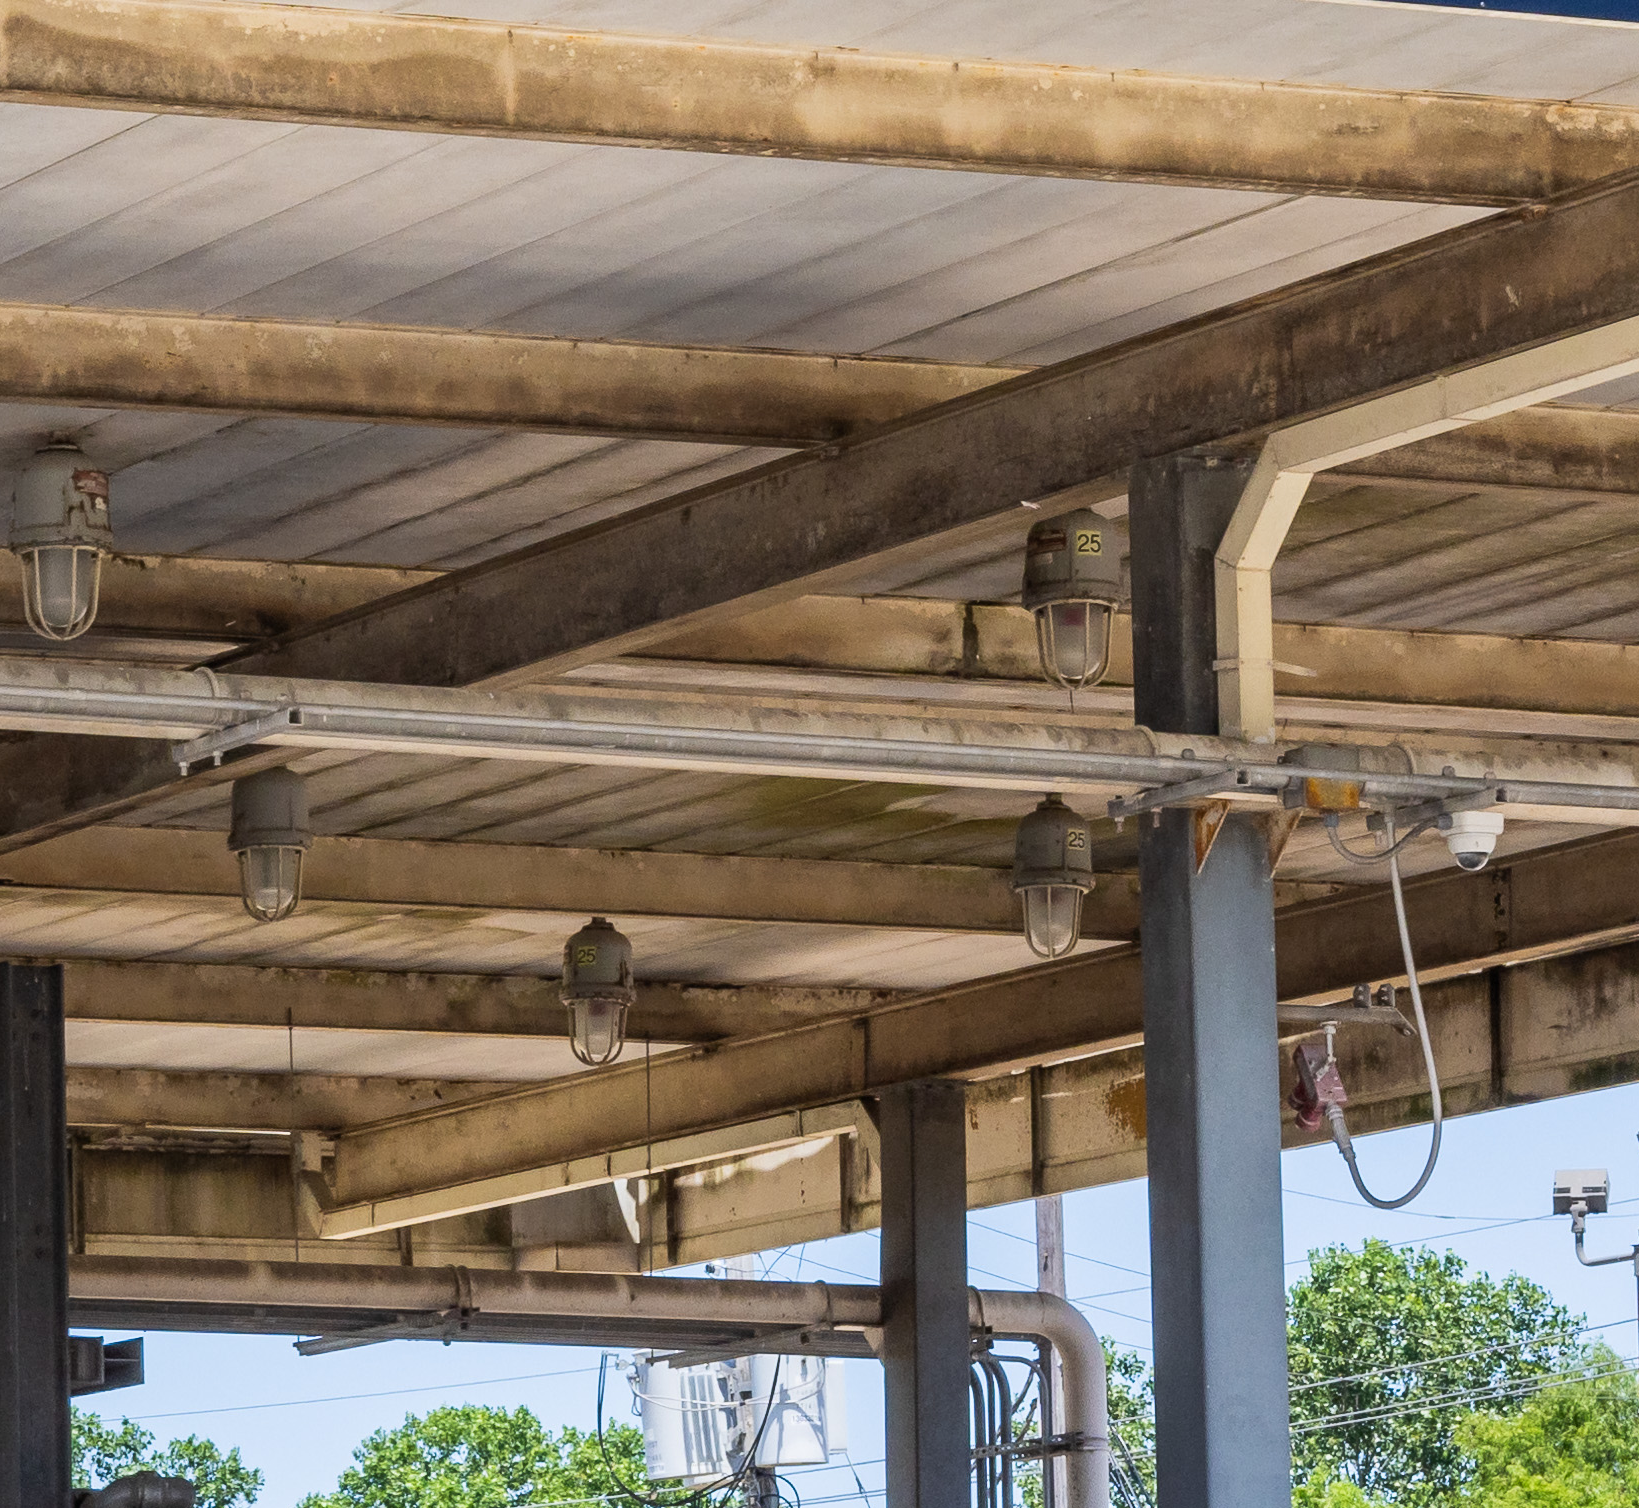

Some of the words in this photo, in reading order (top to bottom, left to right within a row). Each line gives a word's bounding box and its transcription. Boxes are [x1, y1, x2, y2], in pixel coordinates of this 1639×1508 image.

[1077, 534, 1101, 553] 25
[1068, 831, 1085, 848] 25
[578, 949, 596, 963] 25
